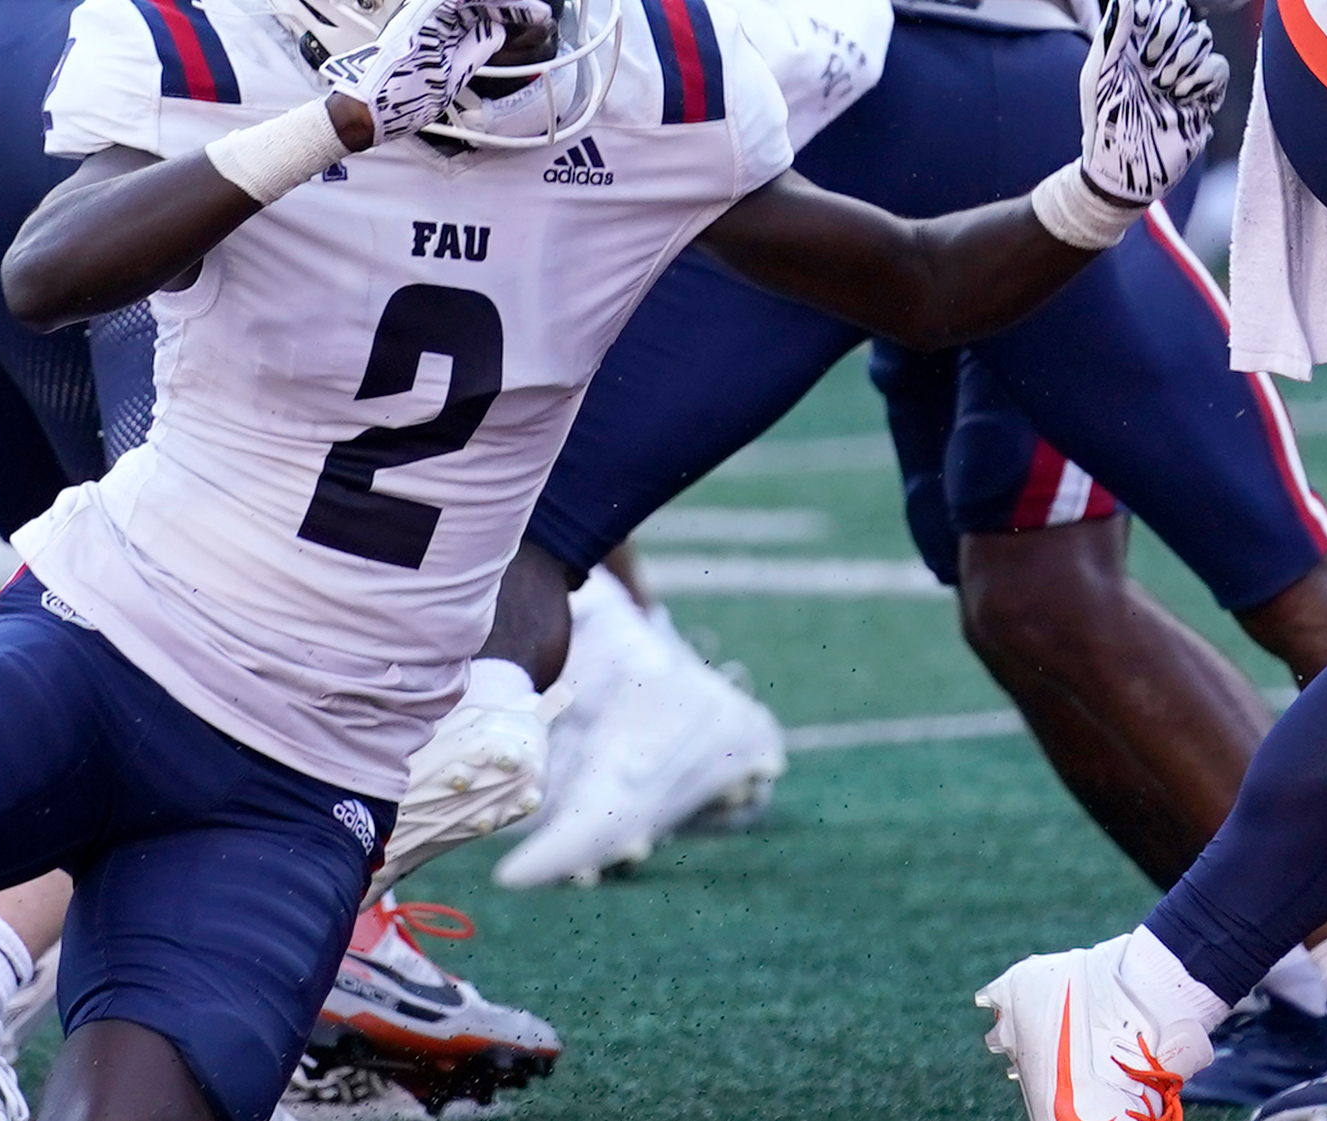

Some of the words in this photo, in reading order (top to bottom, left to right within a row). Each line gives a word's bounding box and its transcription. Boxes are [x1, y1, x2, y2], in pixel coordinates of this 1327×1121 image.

[543, 167, 614, 186] adidas
[411, 221, 491, 262] FAU
[297, 283, 504, 571] 2
